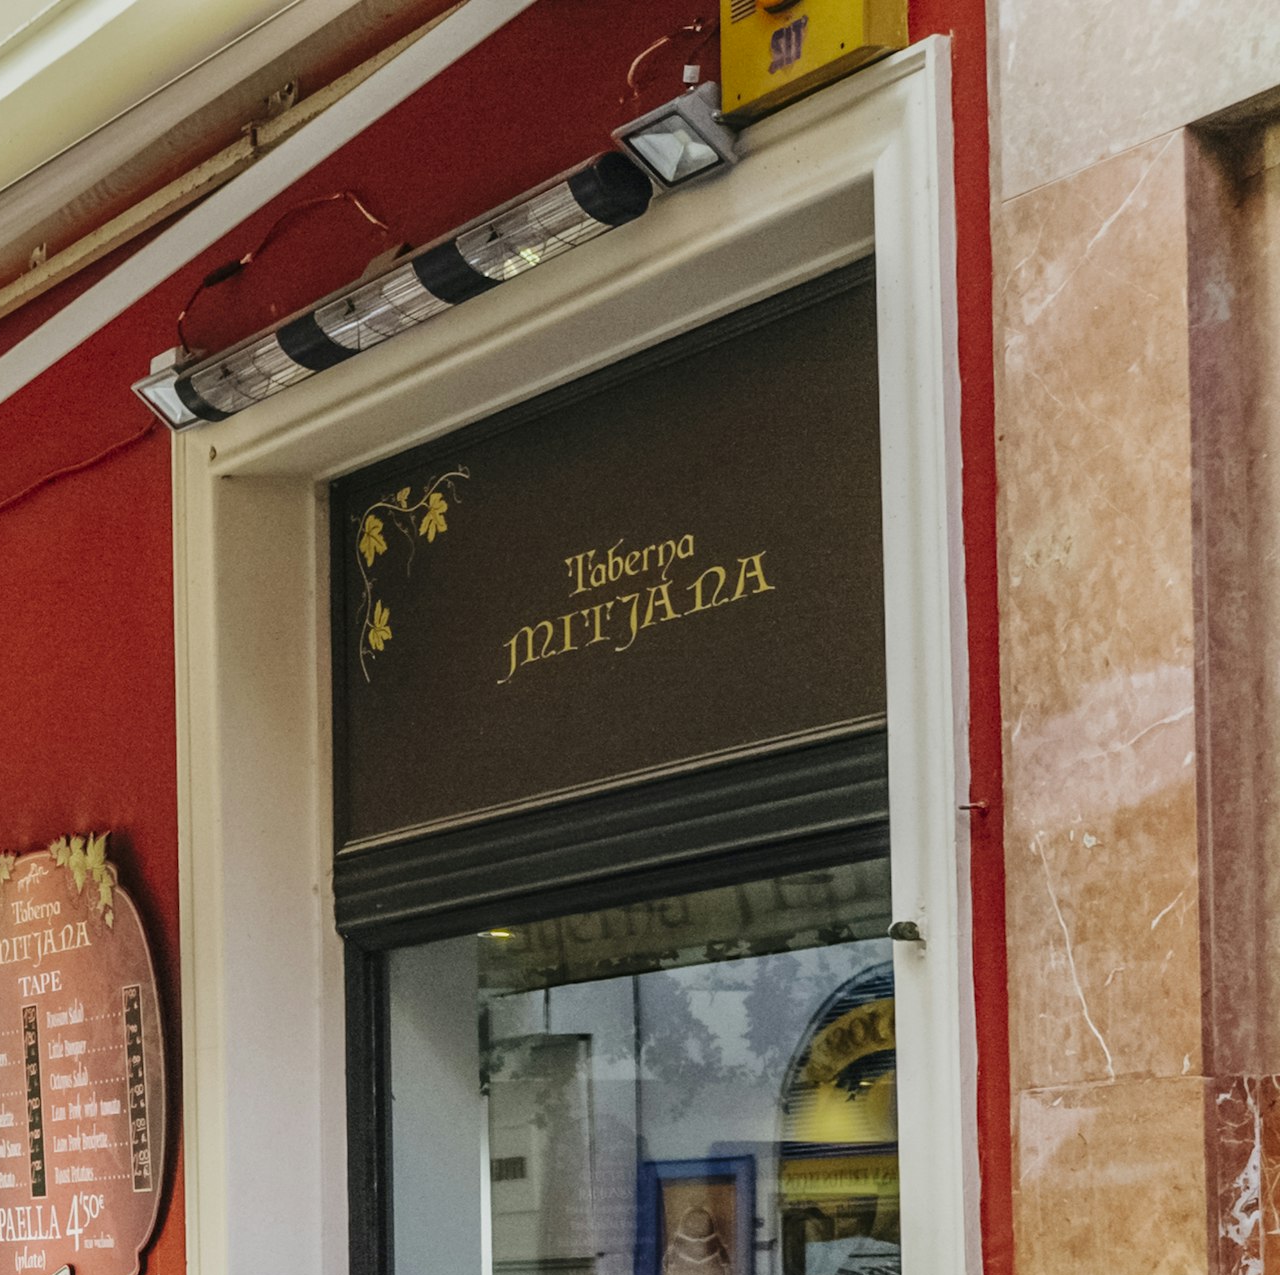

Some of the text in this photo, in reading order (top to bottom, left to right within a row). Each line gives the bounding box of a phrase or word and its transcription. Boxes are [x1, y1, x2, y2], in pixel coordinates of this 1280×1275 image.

[564, 534, 695, 598] Taberna
[497, 551, 776, 685] MITJANA
[11, 898, 62, 925] Taberna
[18, 970, 63, 997] TAPE
[14, 1246, 46, 1275] (plate)
